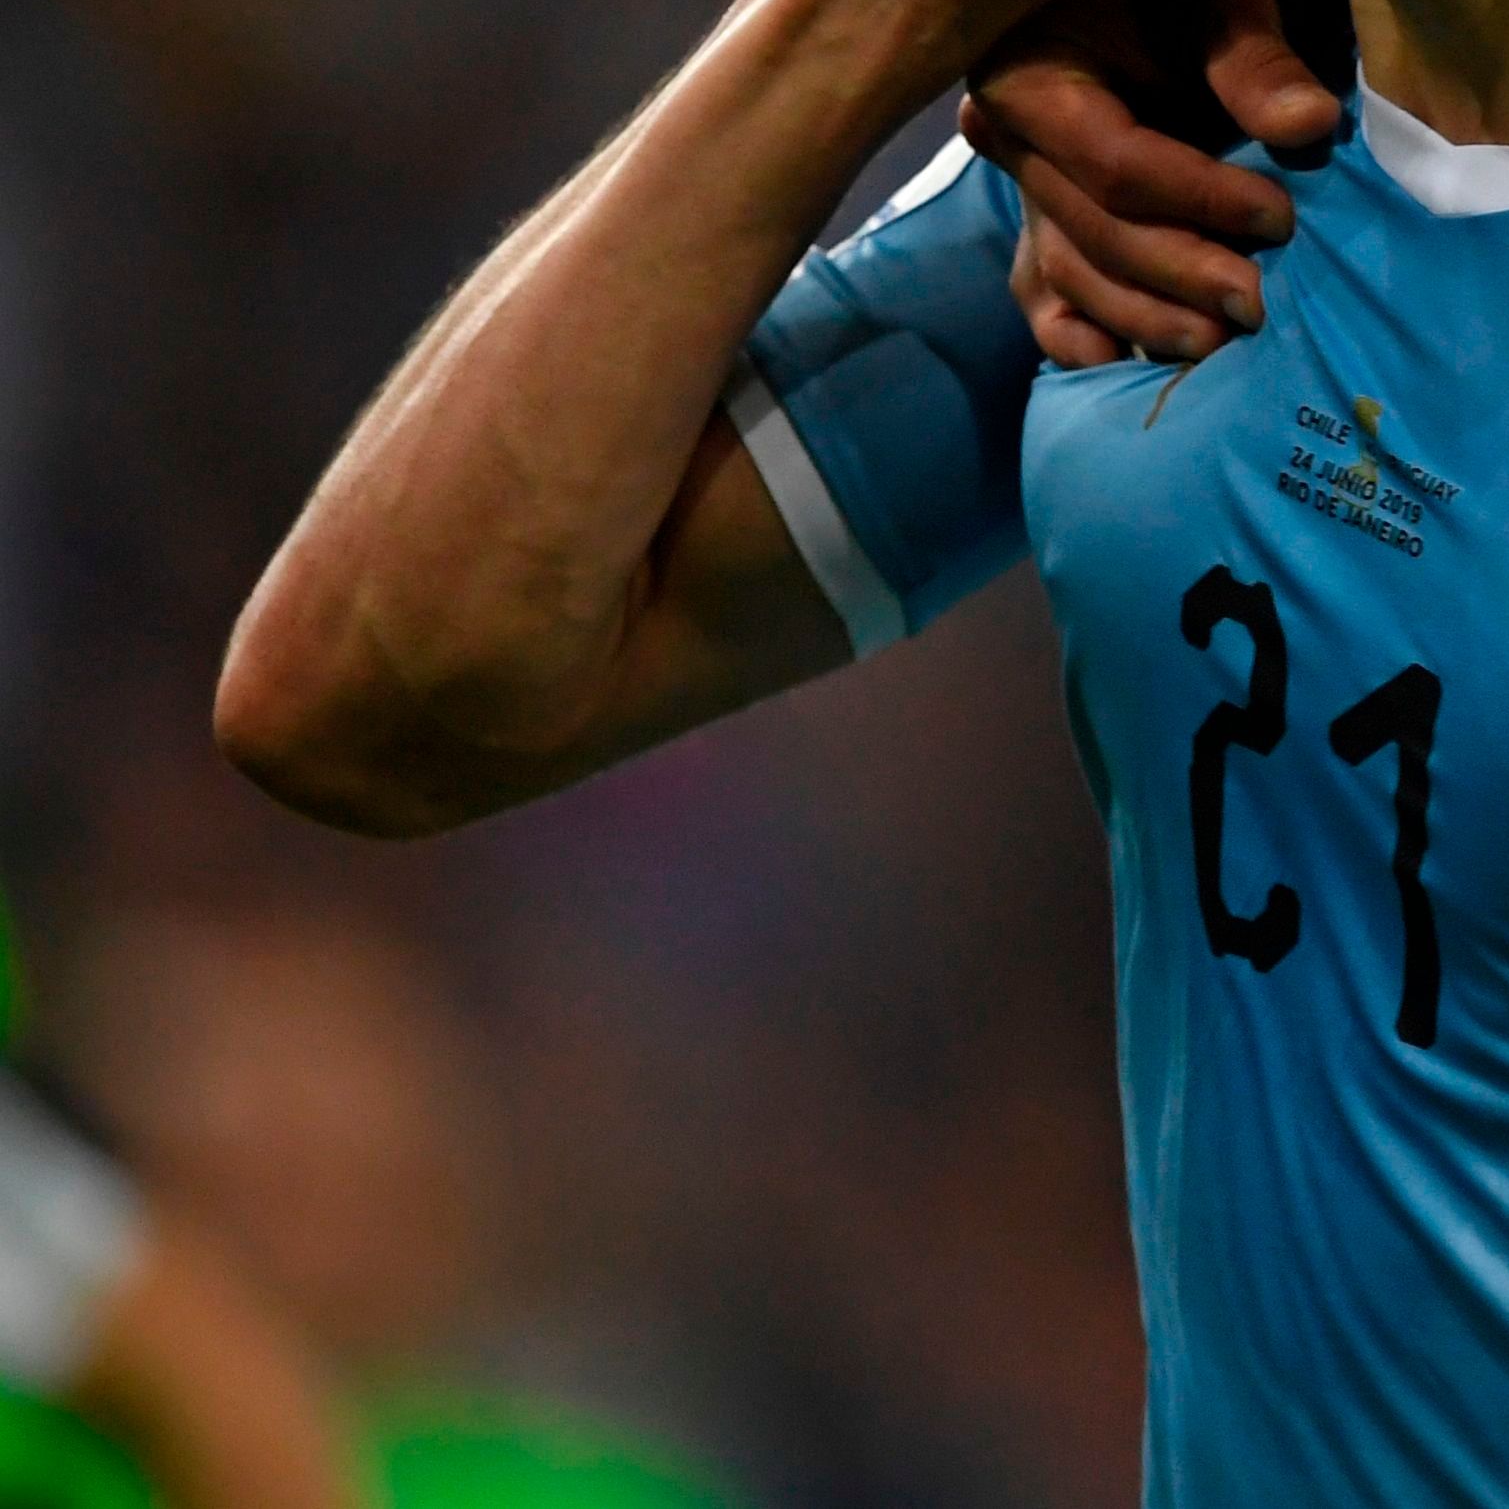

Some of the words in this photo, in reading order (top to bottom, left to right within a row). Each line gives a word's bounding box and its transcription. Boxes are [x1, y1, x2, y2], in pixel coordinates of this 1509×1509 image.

[1291, 446, 1315, 471] 24
[1316, 460, 1377, 500] JUNIO
[1379, 488, 1423, 524] 2019
[1297, 406, 1352, 445] CHILE
[1378, 447, 1461, 502] GUAY
[1277, 471, 1310, 503] RIO
[1315, 489, 1338, 519] DE
[1341, 503, 1423, 558] JANEIRO
[1181, 564, 1442, 1050] 21
